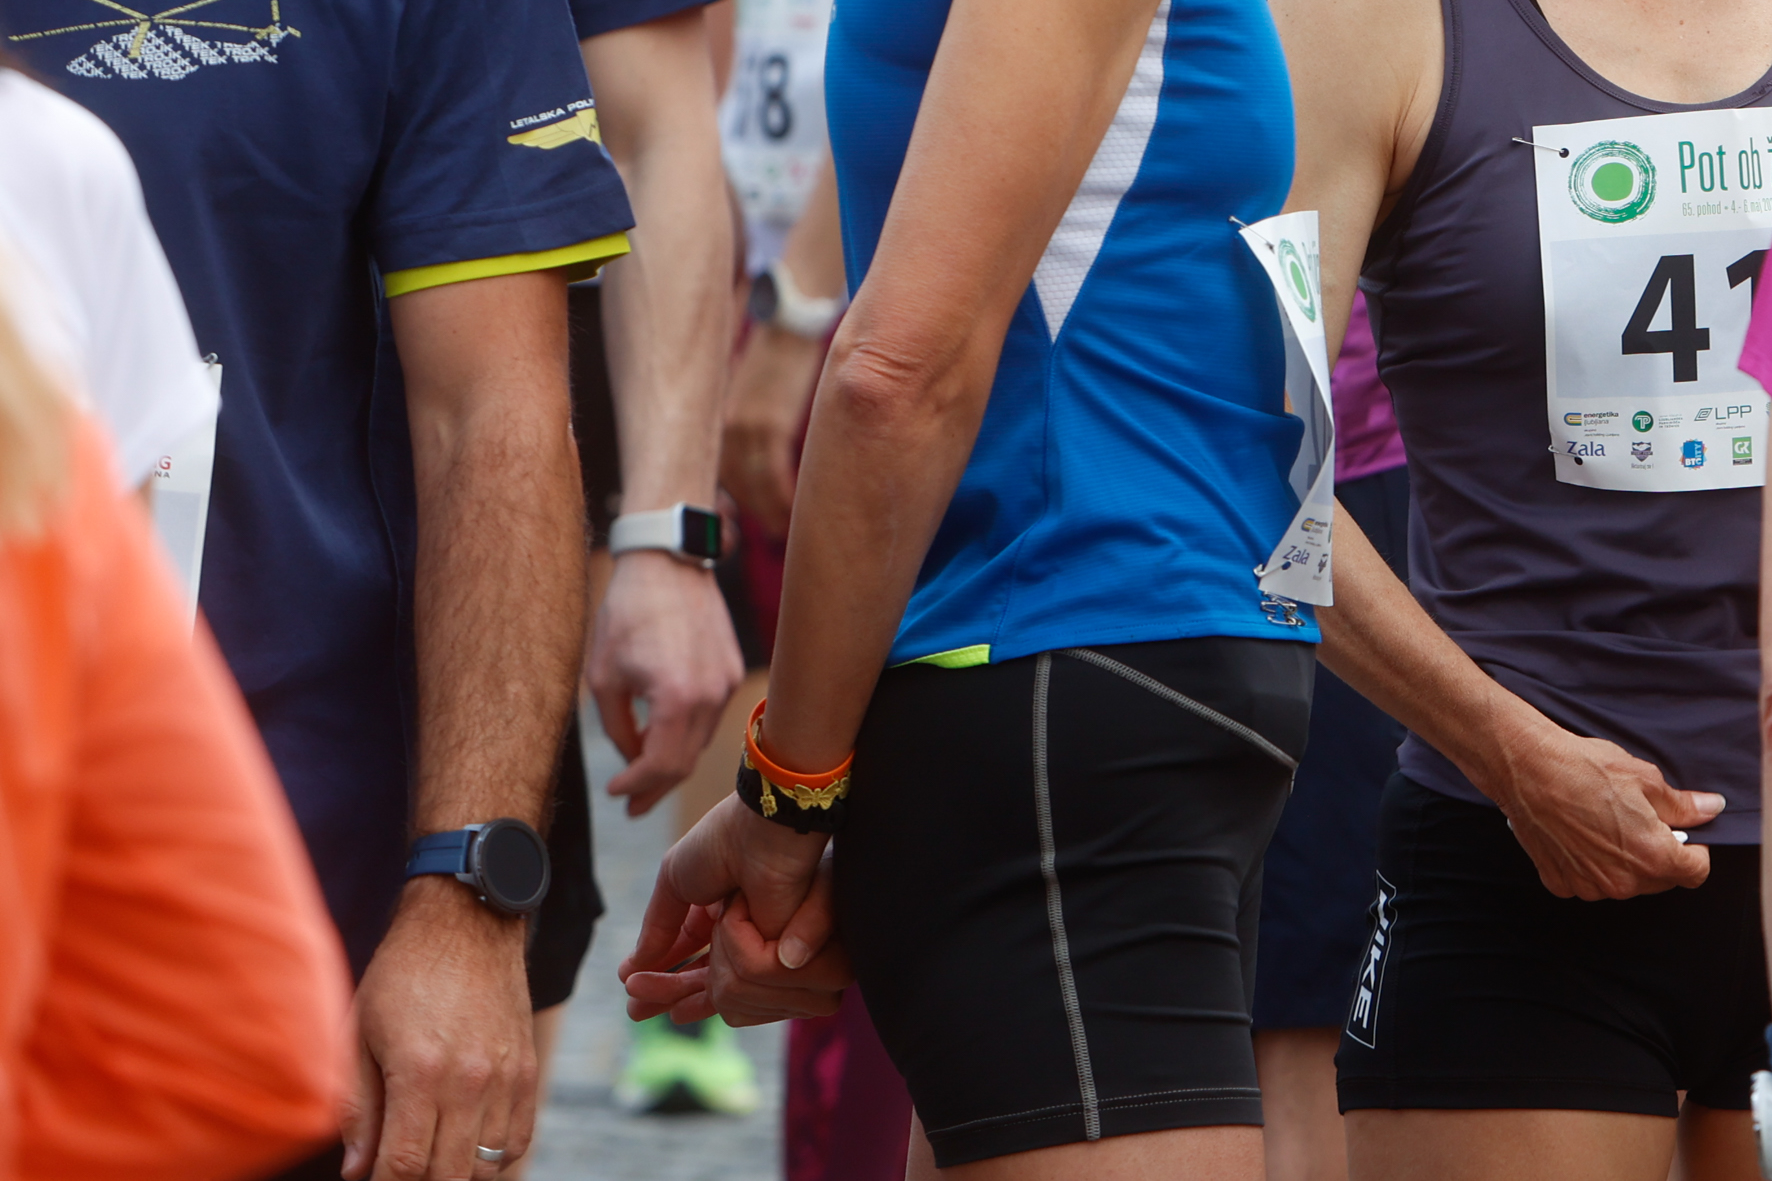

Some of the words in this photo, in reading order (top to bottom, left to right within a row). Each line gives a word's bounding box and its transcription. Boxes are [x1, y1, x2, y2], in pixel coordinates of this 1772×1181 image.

[510, 108, 566, 129] LETALSKA
[1678, 141, 1728, 193] Pot
[1738, 137, 1763, 190] ob
[1682, 202, 1695, 216] 65.
[1697, 201, 1722, 217] pohod
[1584, 412, 1619, 420] energetika
[1715, 405, 1752, 420] LPP
[1566, 441, 1606, 456] Zala
[1685, 458, 1702, 466] BTC
[1283, 545, 1310, 565] Zala
[1353, 889, 1390, 1029] NIKE
